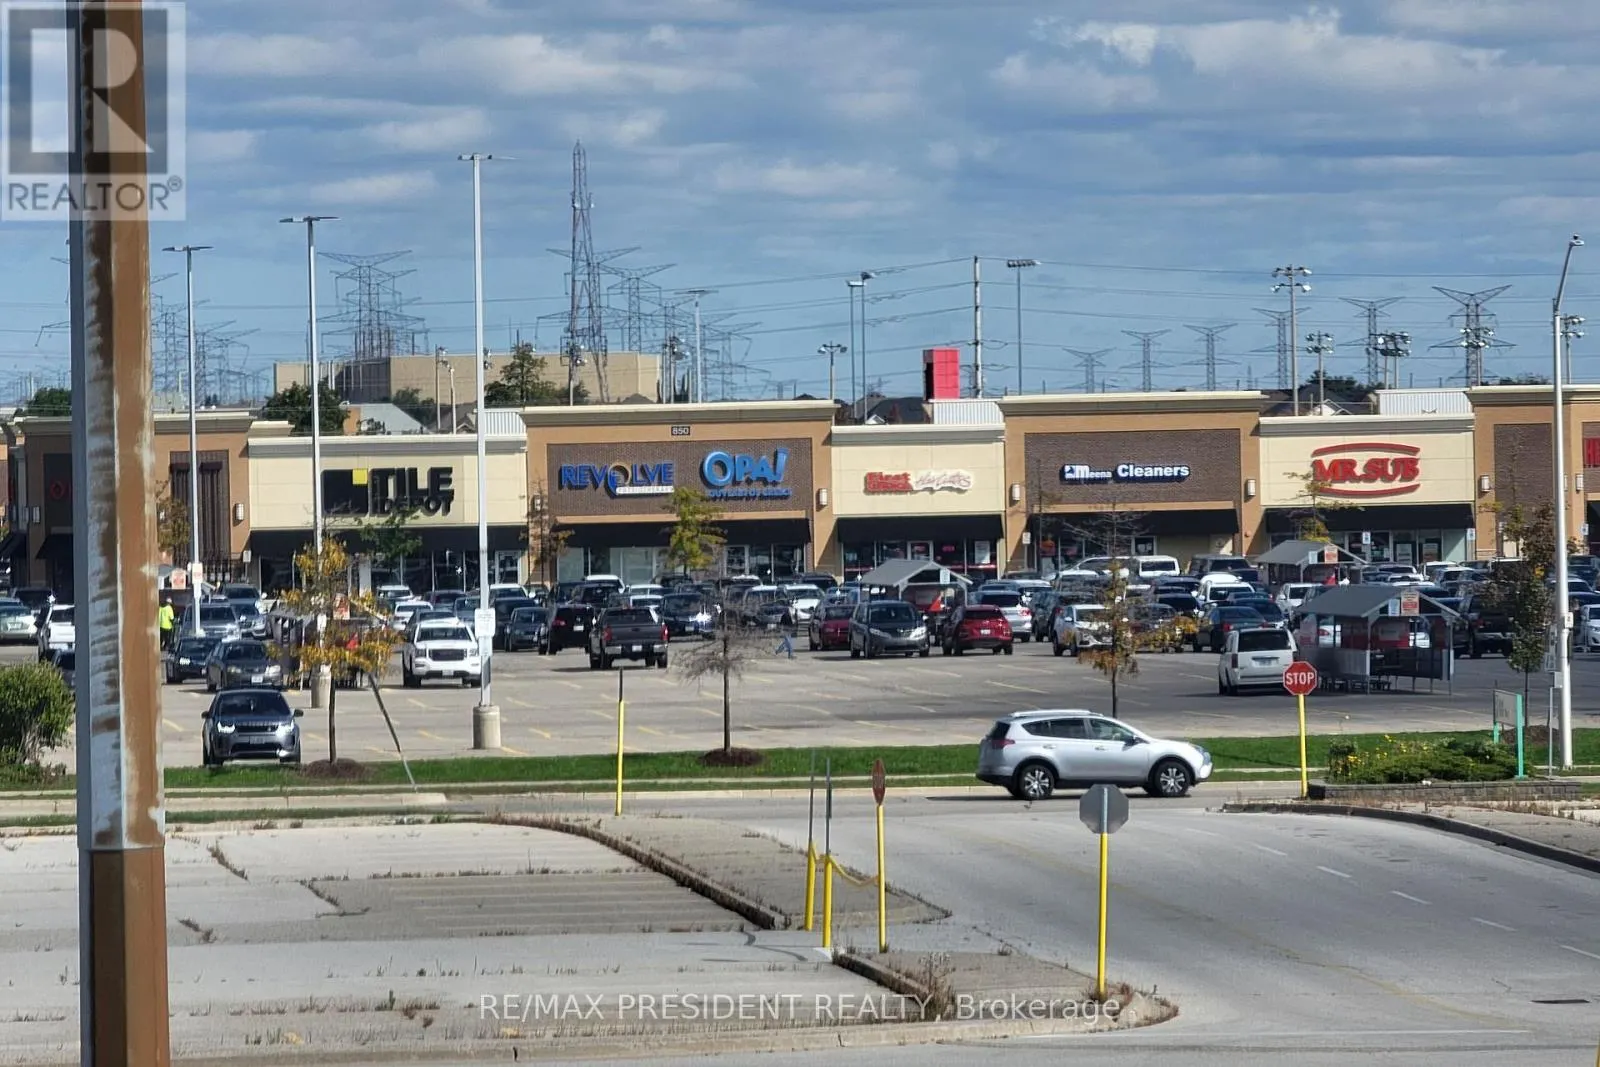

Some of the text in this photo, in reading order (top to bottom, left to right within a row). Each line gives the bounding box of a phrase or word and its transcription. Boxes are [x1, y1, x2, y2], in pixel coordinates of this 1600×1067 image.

[369, 467, 455, 500] TILE
[559, 461, 675, 497] REVOLVE
[699, 448, 788, 488] OPA!
[1116, 463, 1191, 480] Cleaners
[1285, 671, 1315, 686] STOP
